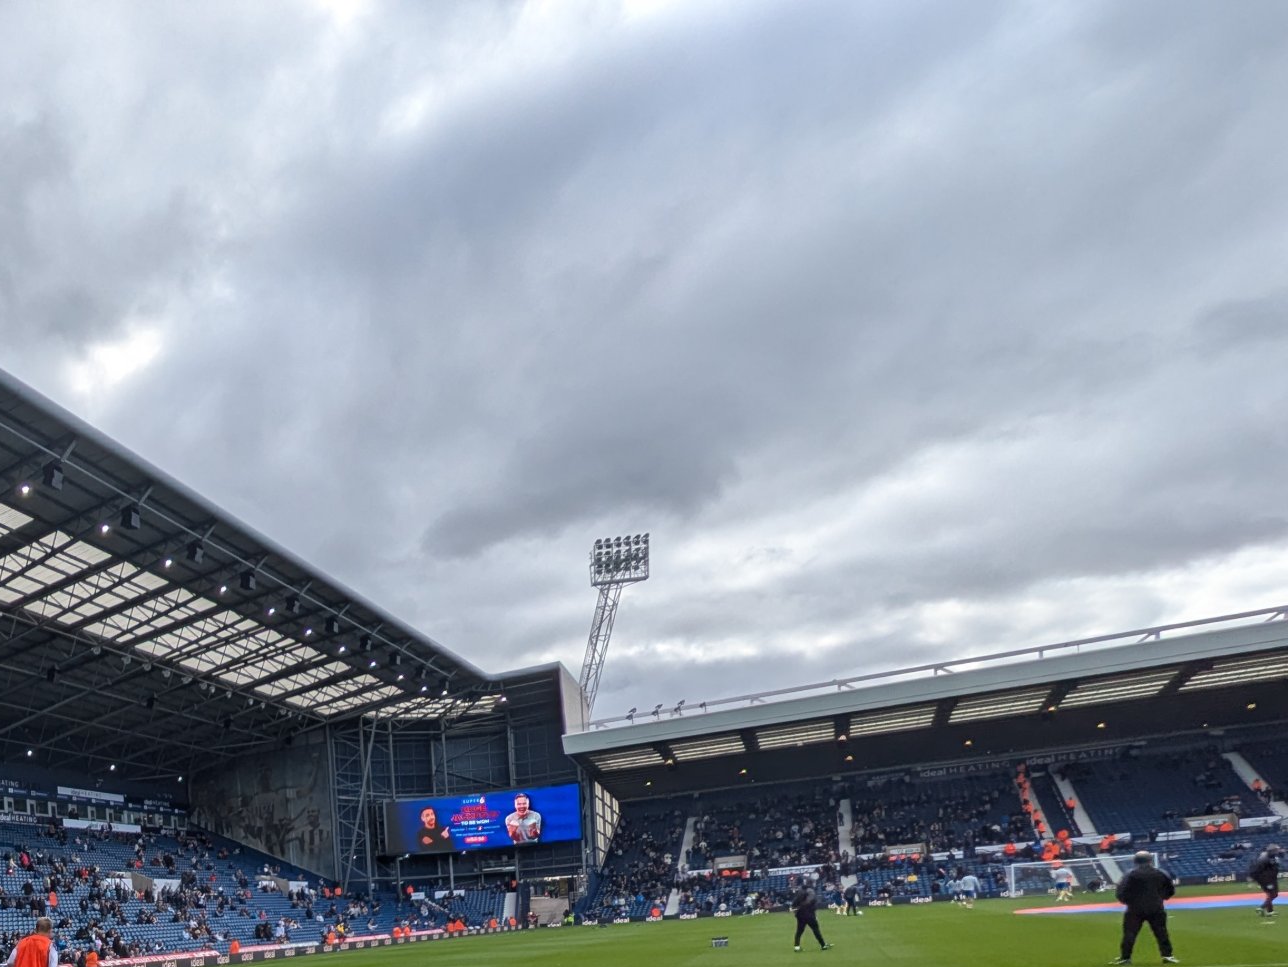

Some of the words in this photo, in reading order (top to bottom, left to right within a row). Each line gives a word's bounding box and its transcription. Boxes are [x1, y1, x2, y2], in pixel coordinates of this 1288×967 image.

[1026, 755, 1055, 766] ideal
[919, 767, 947, 778] ideal
[949, 760, 1011, 774] HEATING
[12, 814, 38, 824] HEATING
[1207, 872, 1236, 883] ideal
[910, 895, 933, 904] ideal
[680, 912, 698, 920] ideal
